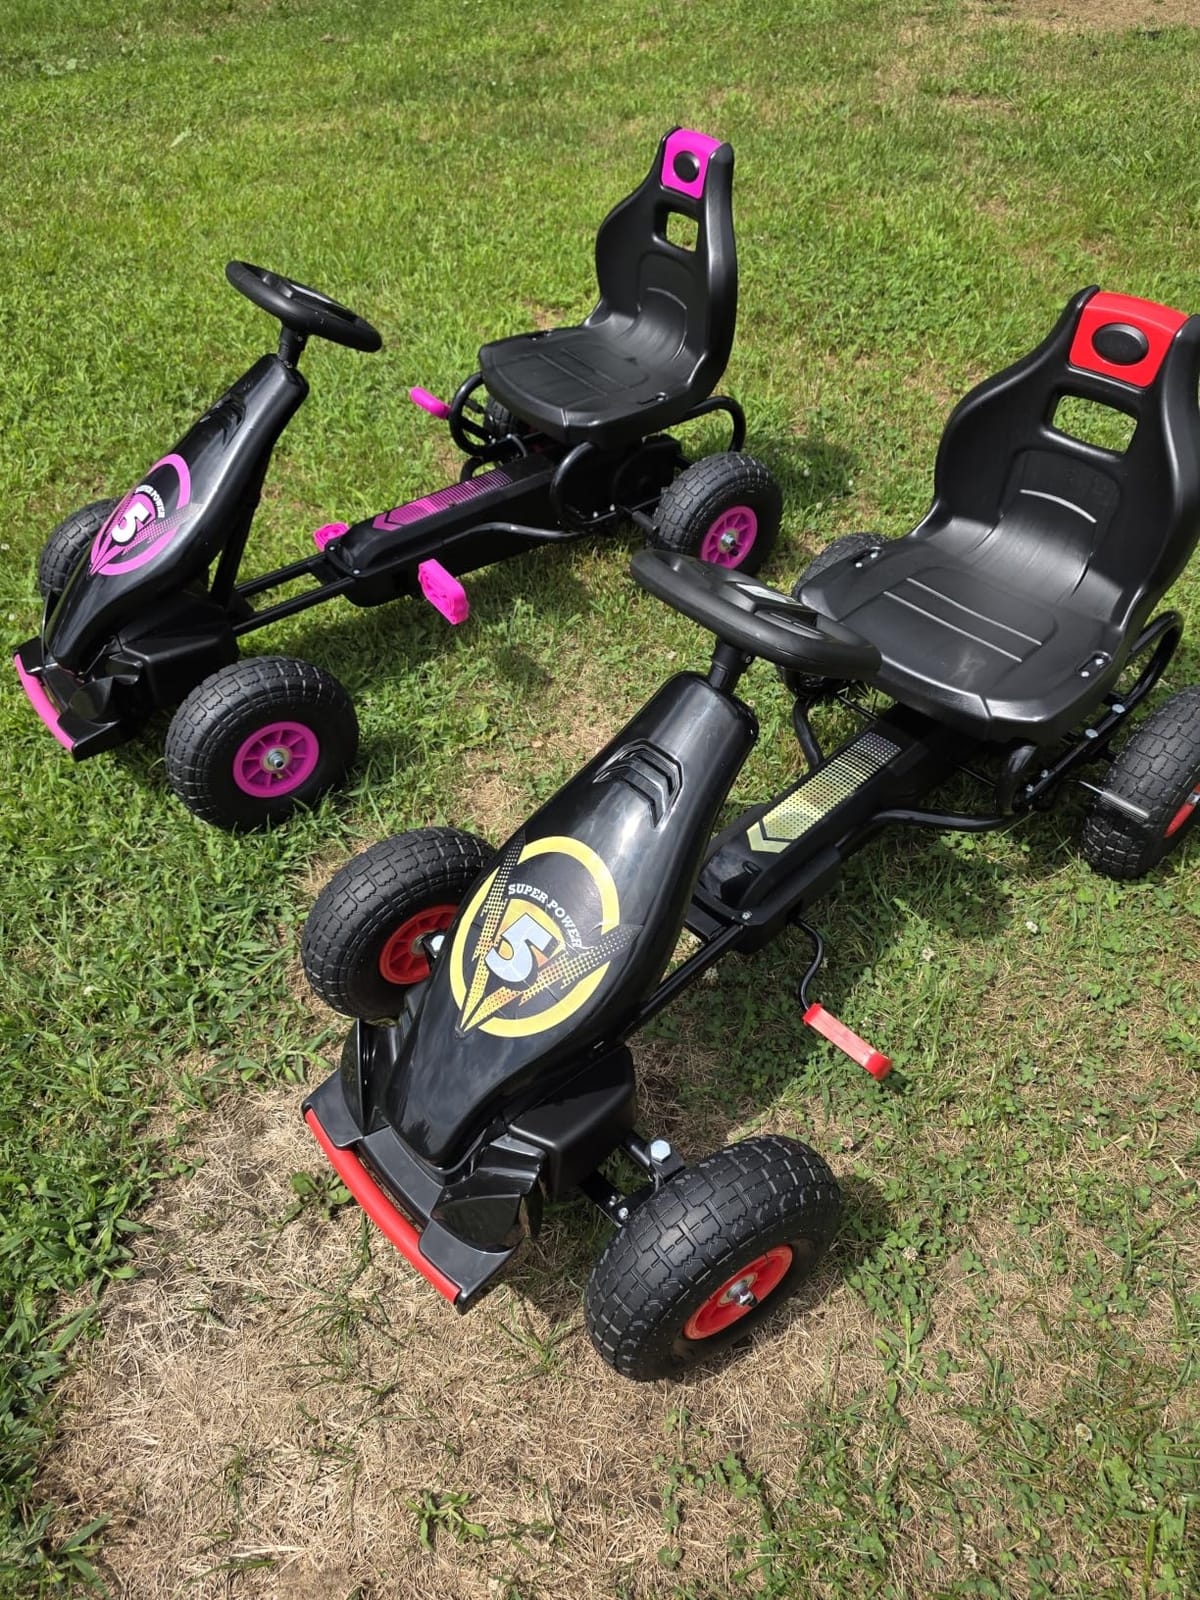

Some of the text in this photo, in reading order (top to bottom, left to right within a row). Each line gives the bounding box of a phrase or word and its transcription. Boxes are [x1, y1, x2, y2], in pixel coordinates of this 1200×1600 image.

[111, 501, 151, 543] 5
[484, 912, 553, 983] 5
[508, 883, 583, 948] SUPER POWER
